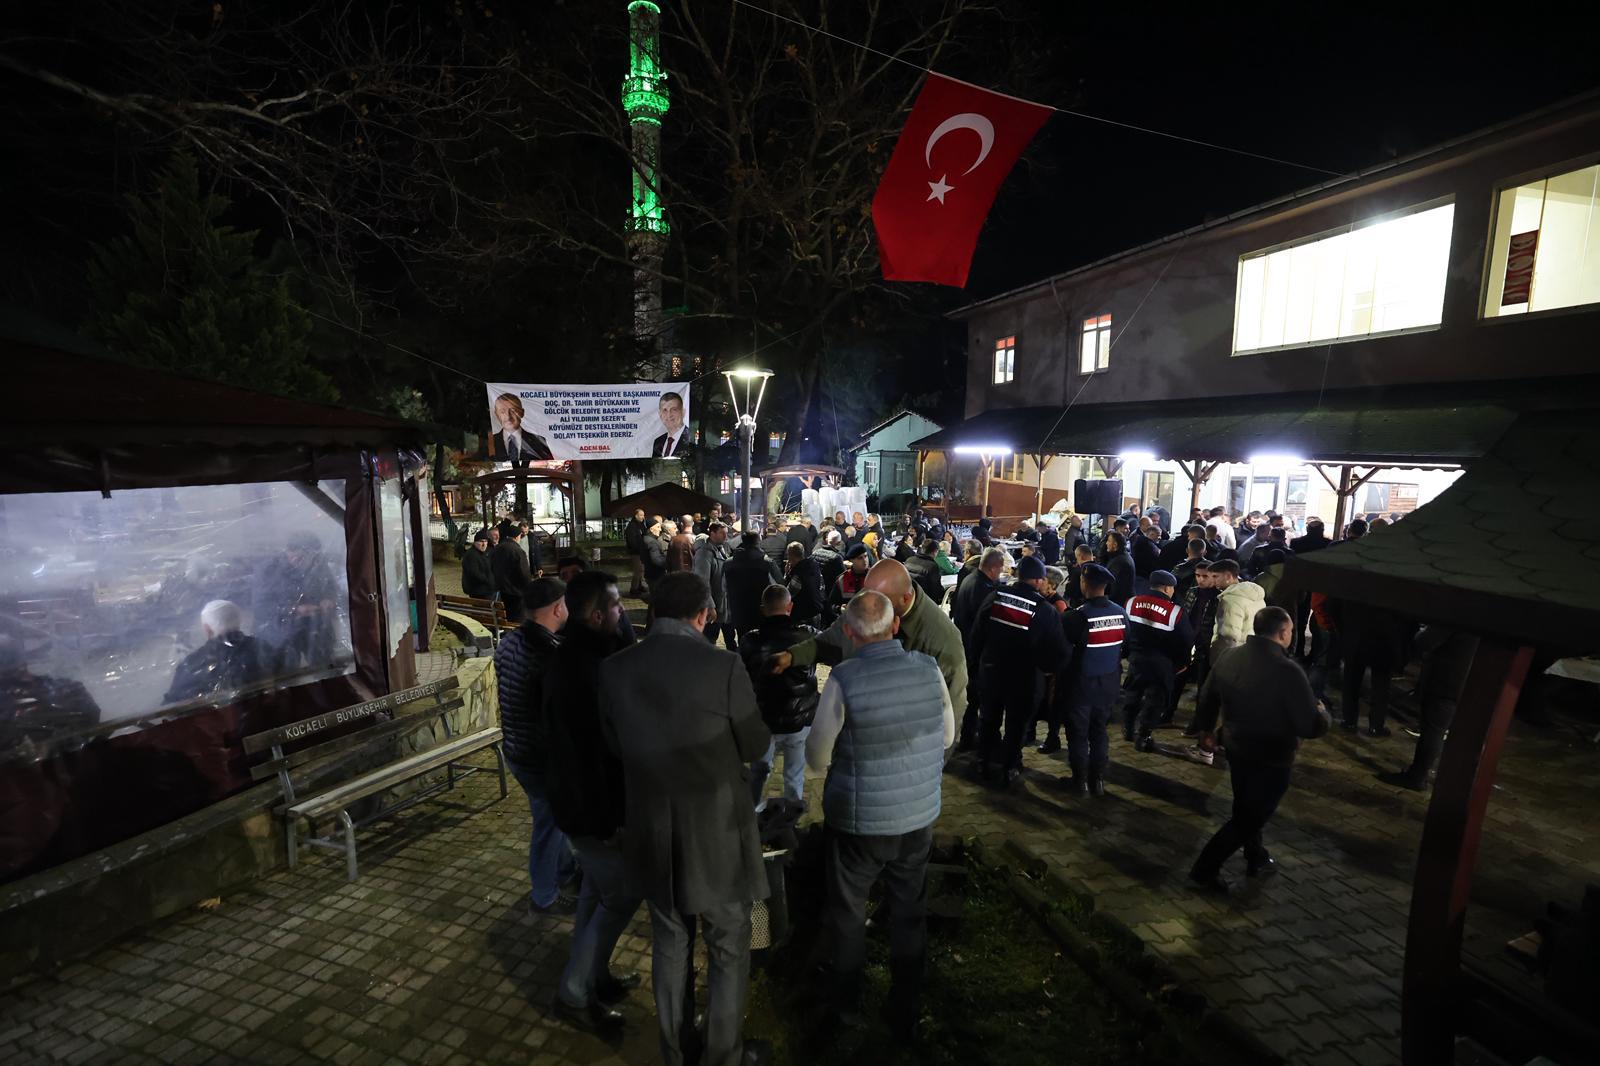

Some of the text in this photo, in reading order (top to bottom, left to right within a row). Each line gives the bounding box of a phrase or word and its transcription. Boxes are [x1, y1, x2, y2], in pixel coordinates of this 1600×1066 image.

[623, 390, 661, 398] BAŞKANIMIZ
[544, 407, 569, 415] GÖLCÜK
[603, 407, 641, 416] BAŞKANIMIZ
[578, 431, 609, 440] TEŞEKKÜR
[1135, 602, 1167, 616] JANDARMA
